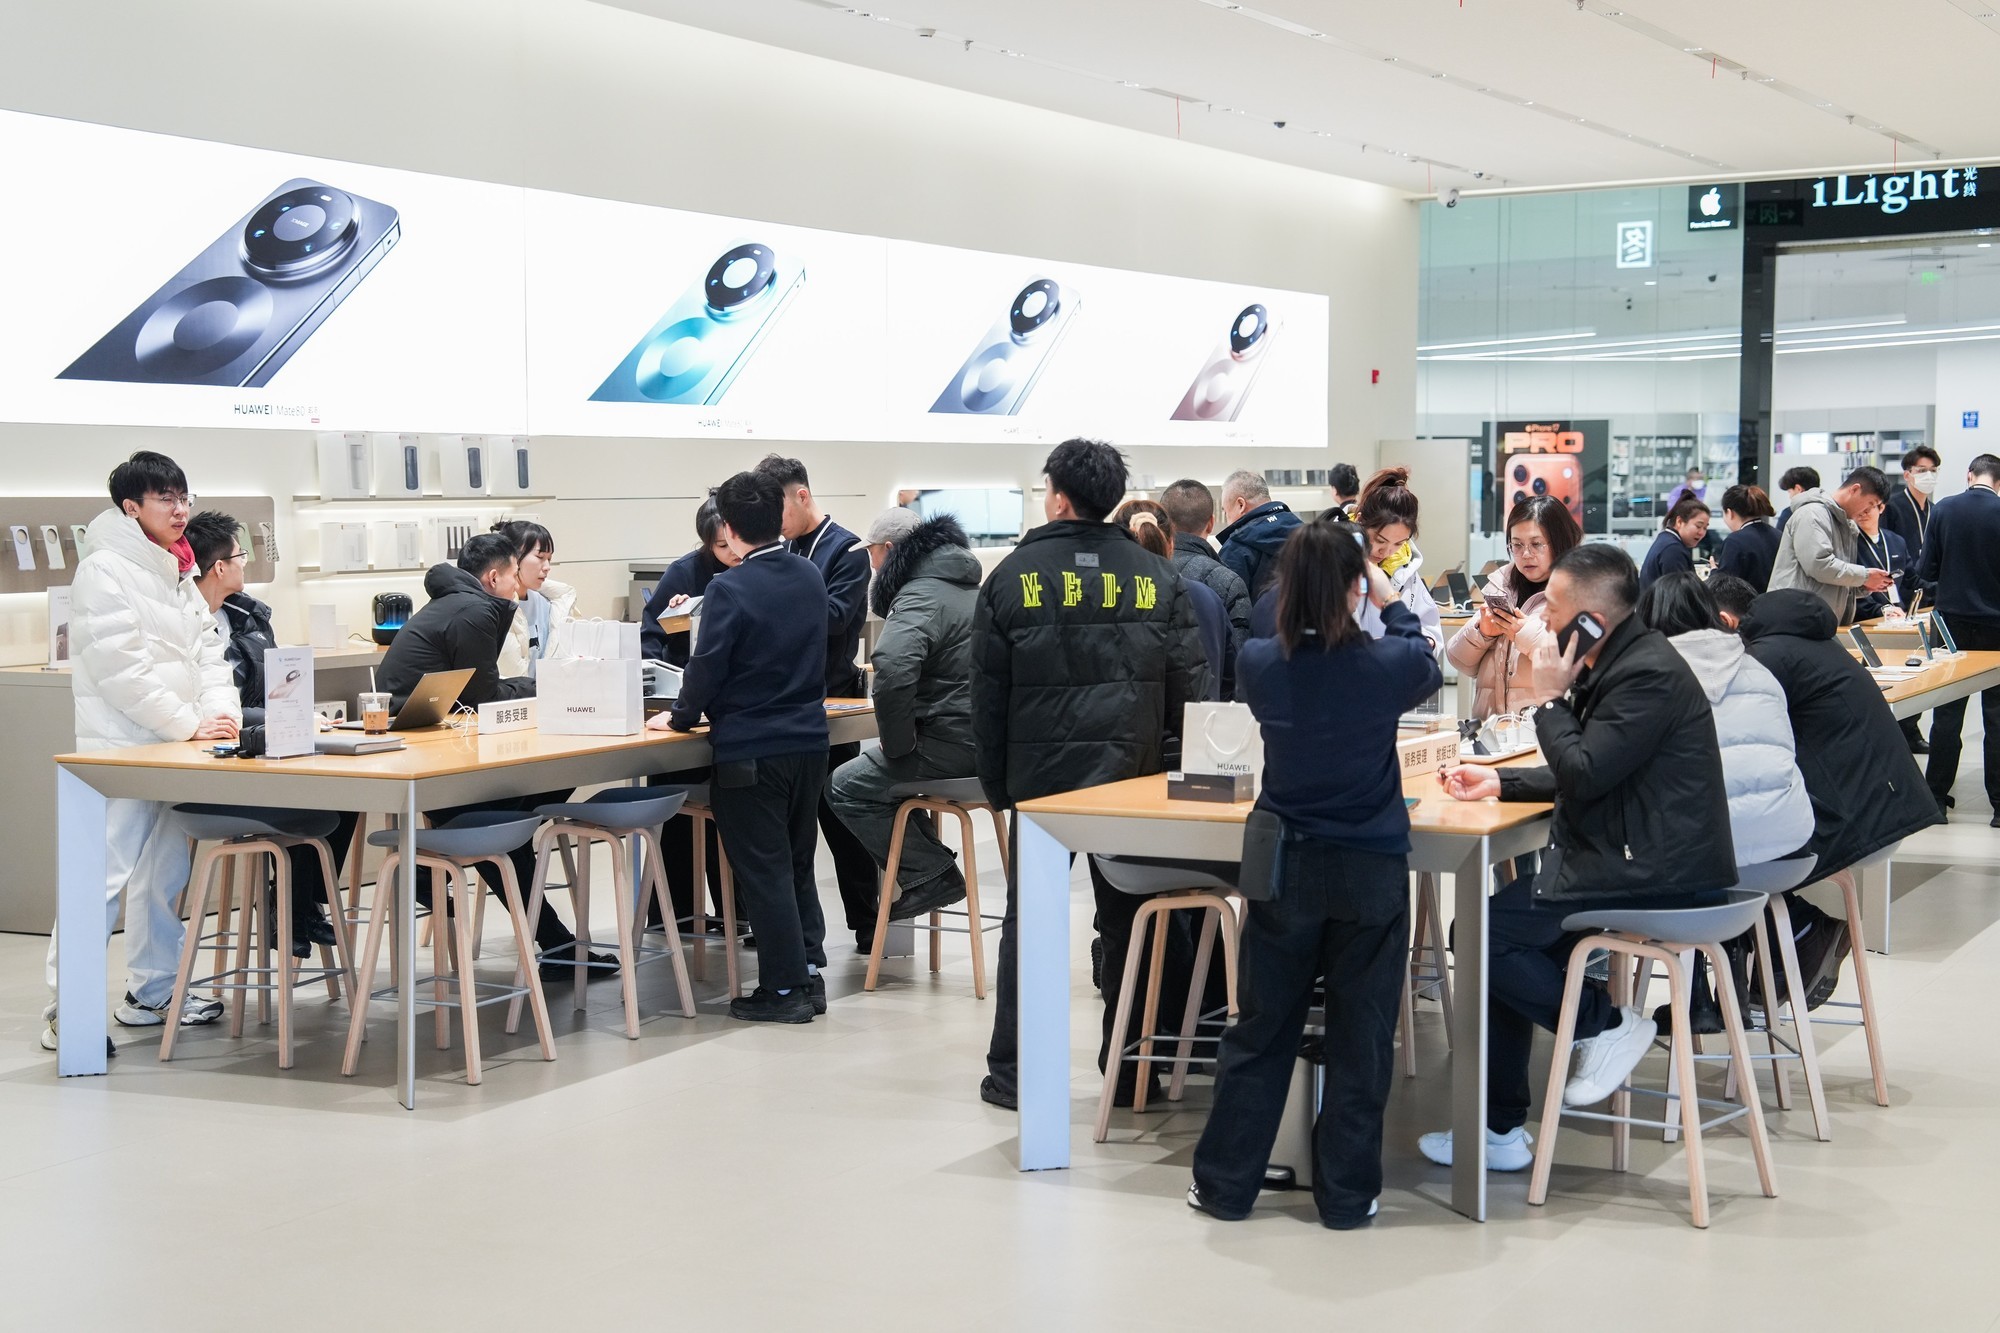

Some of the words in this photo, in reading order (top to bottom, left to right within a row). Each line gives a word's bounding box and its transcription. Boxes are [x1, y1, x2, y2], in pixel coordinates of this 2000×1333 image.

[1812, 167, 1960, 214] iLight
[234, 404, 273, 415] HUAWEI
[1504, 431, 1584, 454] PRO
[496, 707, 528, 724] 服务受理
[567, 706, 596, 714] HUAWEI
[1404, 748, 1428, 768] 服务受理
[1436, 743, 1457, 762] 数据迁移
[1217, 763, 1250, 772] HUAWEI
